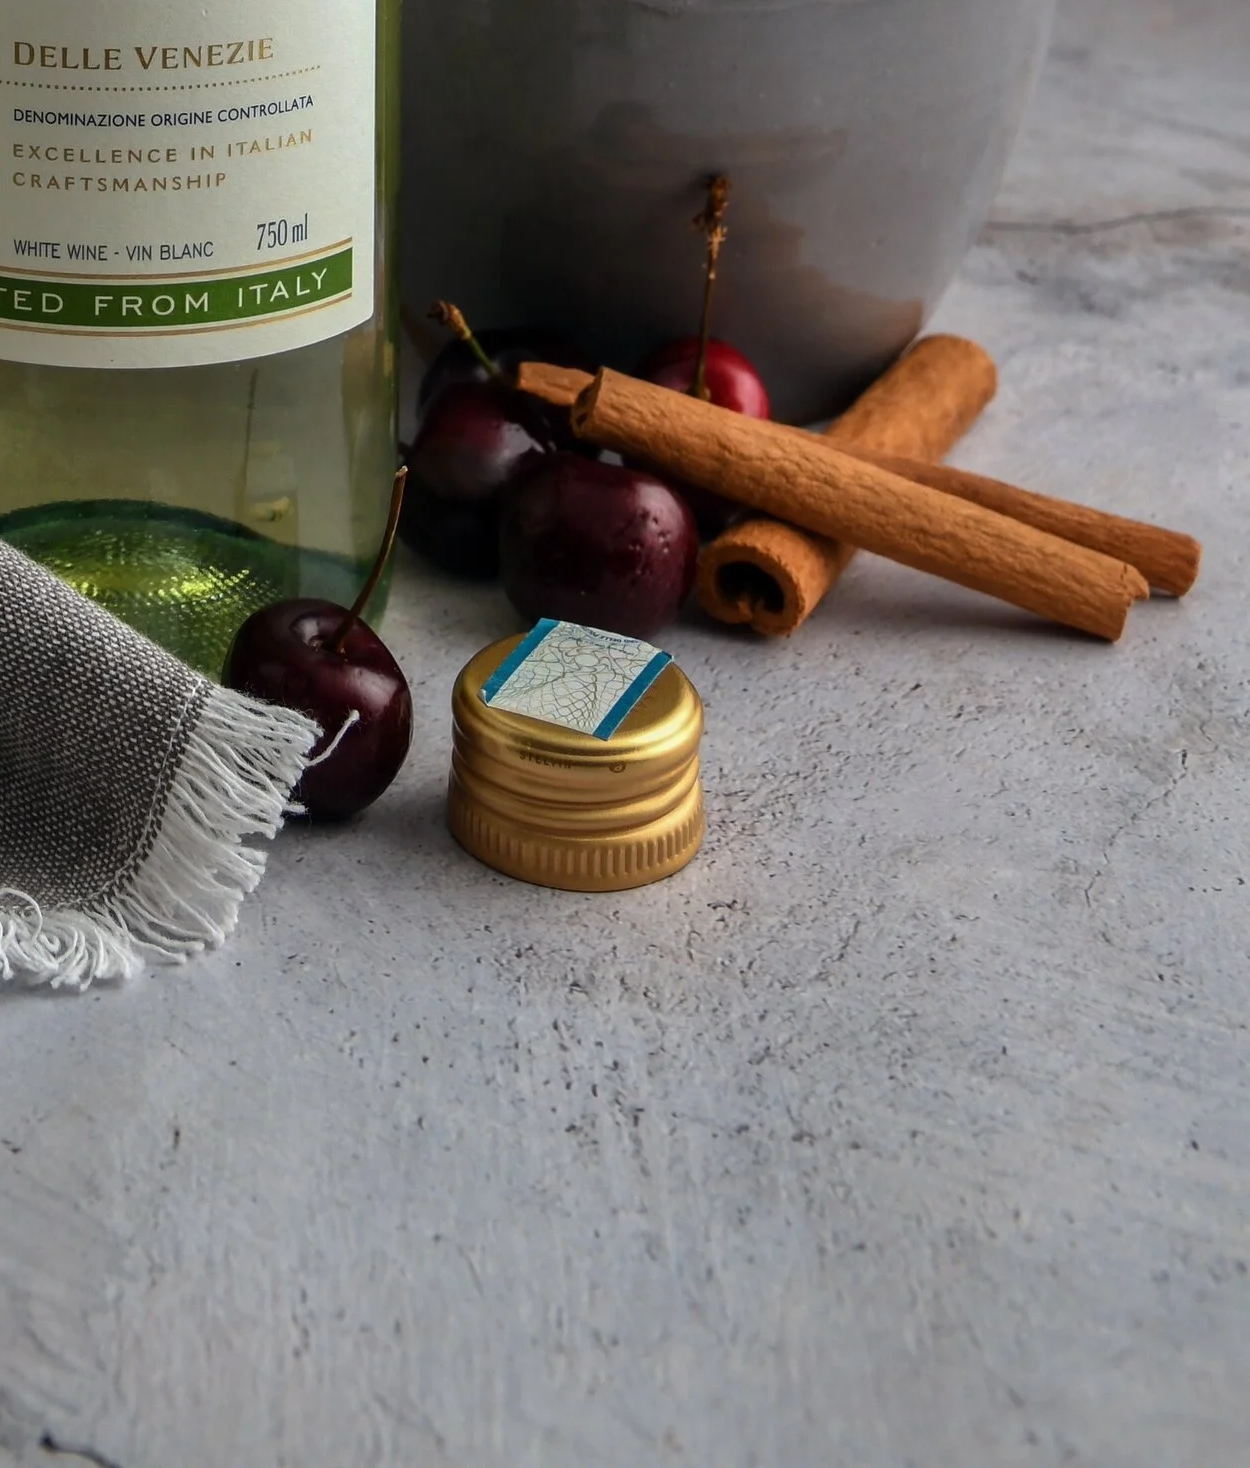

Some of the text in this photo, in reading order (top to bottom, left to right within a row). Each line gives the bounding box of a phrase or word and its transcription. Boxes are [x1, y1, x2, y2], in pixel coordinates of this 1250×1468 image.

[13, 37, 274, 70] DELLE VENEZIE
[13, 94, 314, 127] DENOMINAZIONE ORIGINE CONTROLLATA
[13, 128, 313, 164] EXCELLENCE IN ITALIAN
[12, 172, 227, 193] CRAFTSMANSHIP
[256, 212, 308, 251] 750 ml
[13, 239, 61, 259] WHITE
[67, 243, 108, 261] WINE
[125, 244, 153, 262] VIN
[159, 241, 214, 261] BLANC
[94, 292, 209, 316] FROM
[238, 267, 328, 308] ITALY
